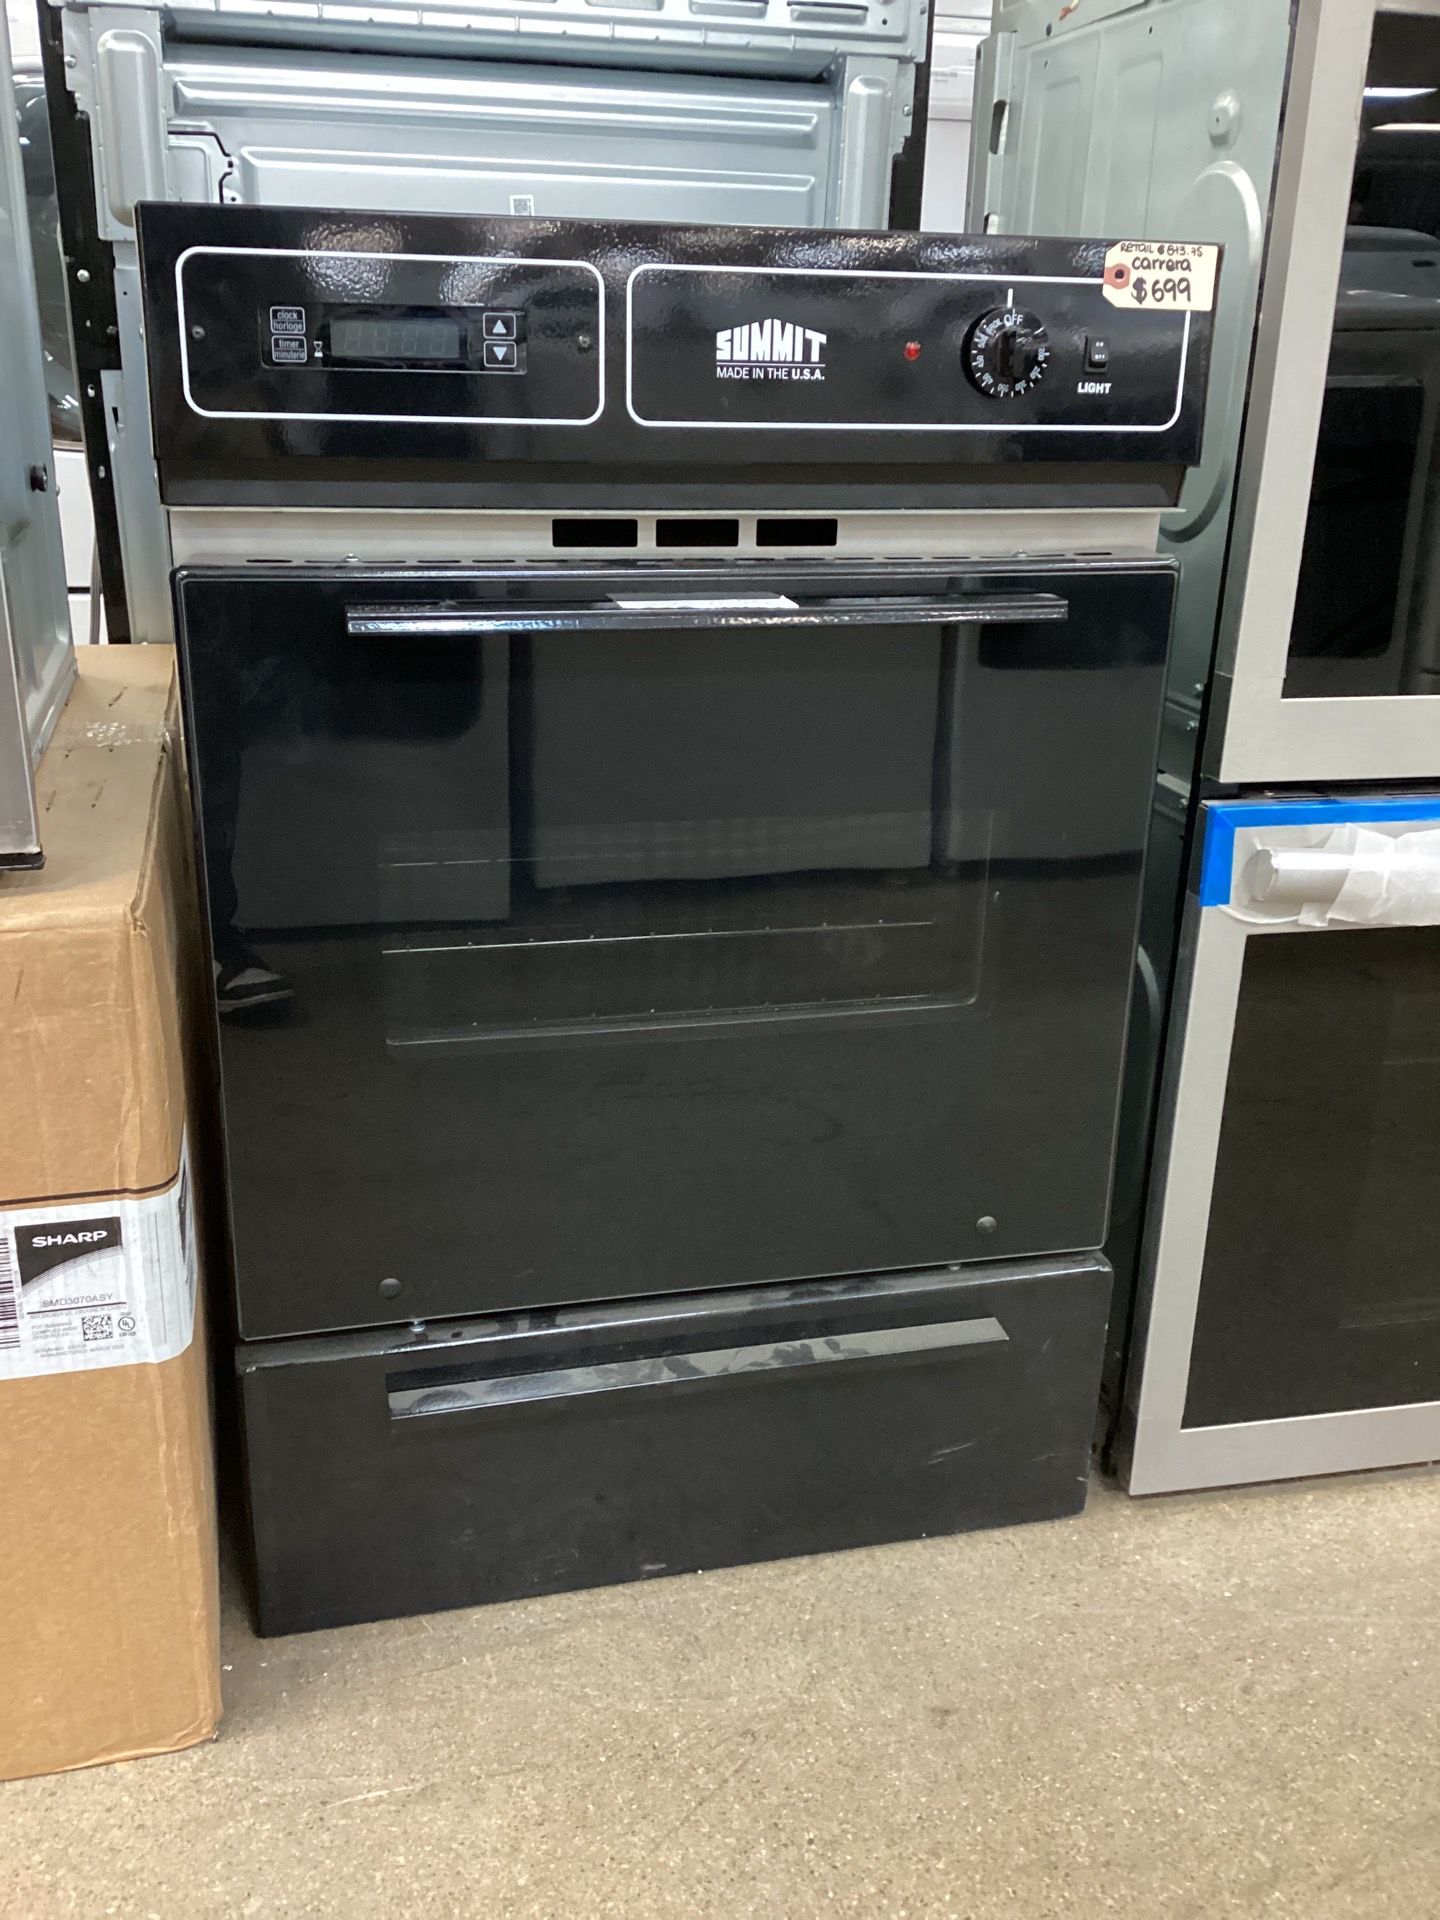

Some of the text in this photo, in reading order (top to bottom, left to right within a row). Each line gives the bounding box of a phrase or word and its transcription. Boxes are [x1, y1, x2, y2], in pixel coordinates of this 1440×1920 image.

[1120, 242, 1154, 254] RETAIL
[1131, 256, 1192, 272] carrera
[1131, 277, 1191, 305] $699
[277, 310, 298, 319] clock
[1003, 313, 1024, 327] OFF
[273, 321, 303, 332] horloge
[279, 339, 299, 348] timer
[716, 318, 827, 362] SUMMIT
[716, 366, 825, 380] MADE IN THE U.S.A.
[1077, 382, 1112, 394] LIGHT
[32, 1230, 108, 1248] SHARP
